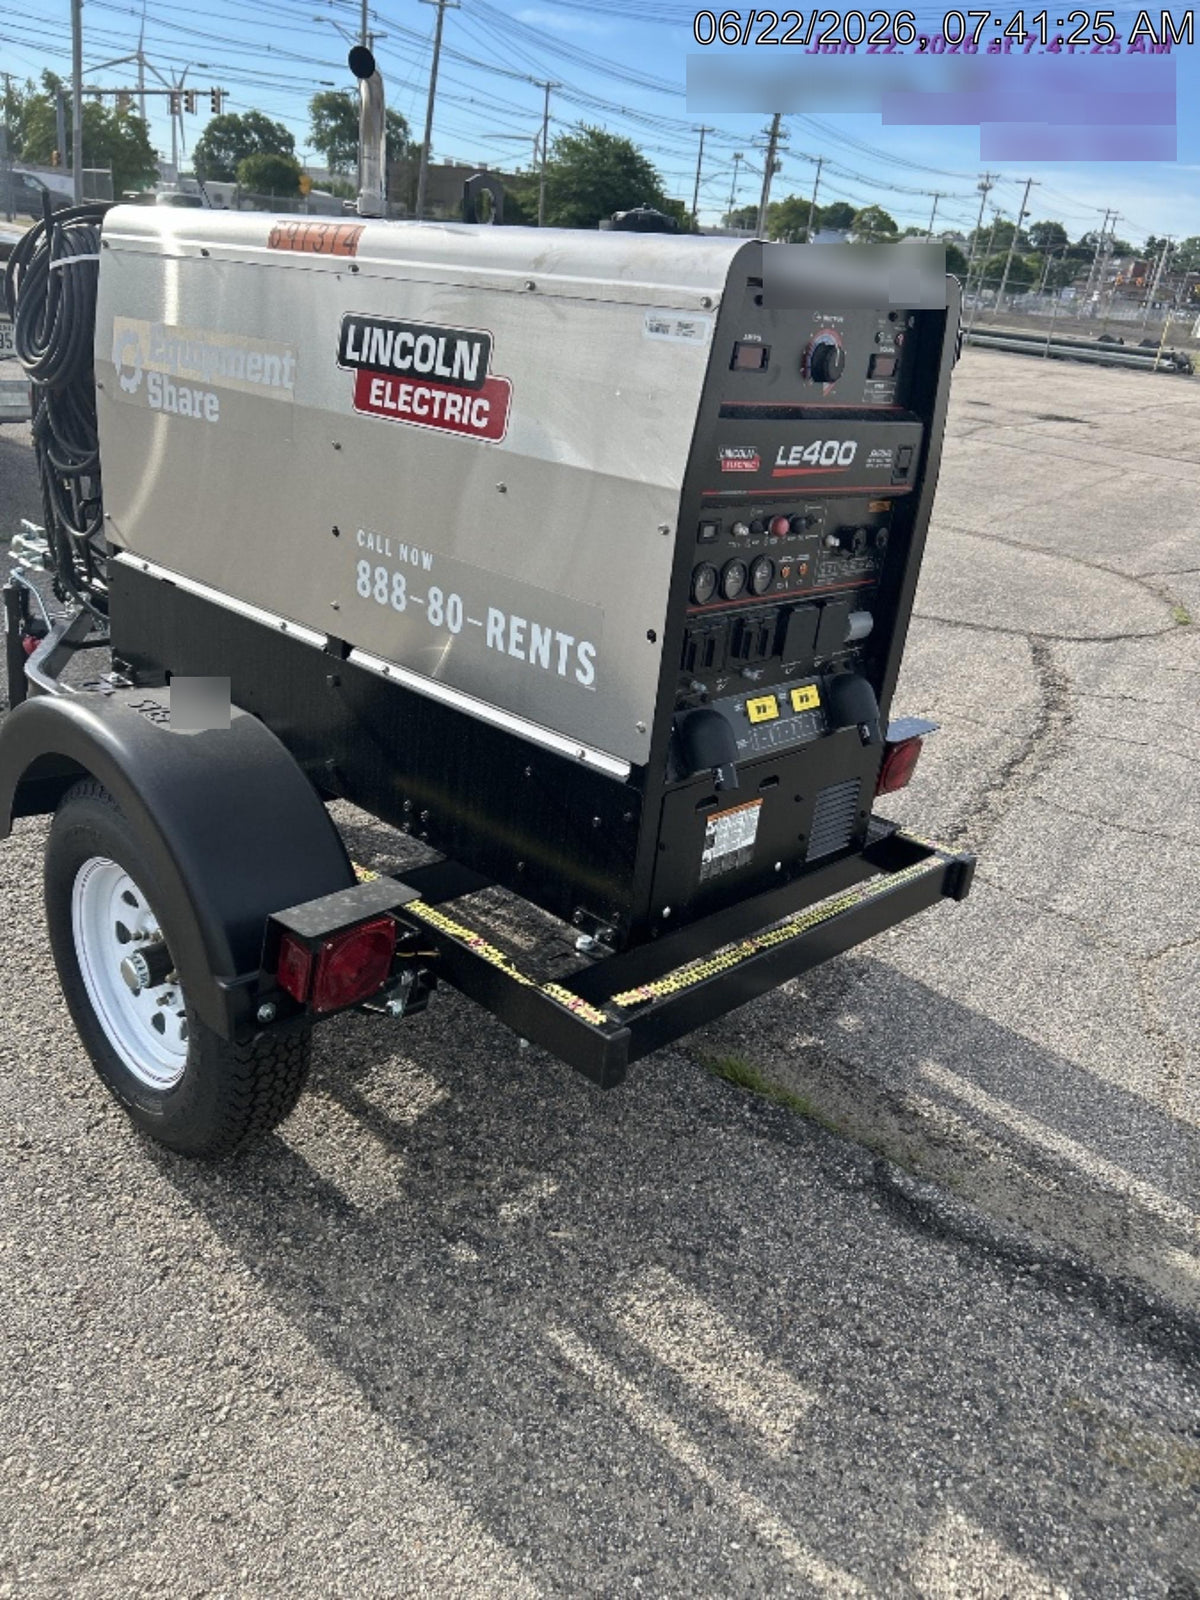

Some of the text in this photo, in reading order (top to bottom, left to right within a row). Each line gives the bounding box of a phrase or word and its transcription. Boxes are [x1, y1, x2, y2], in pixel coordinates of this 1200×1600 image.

[150, 322, 296, 390] Equipment
[346, 323, 482, 382] LINCOLN
[147, 371, 219, 422] Share
[369, 380, 490, 429] ELECTRIC
[775, 440, 858, 466] LE400
[357, 528, 433, 571] CALL NOW
[356, 559, 596, 686] 888-80-RENTS
